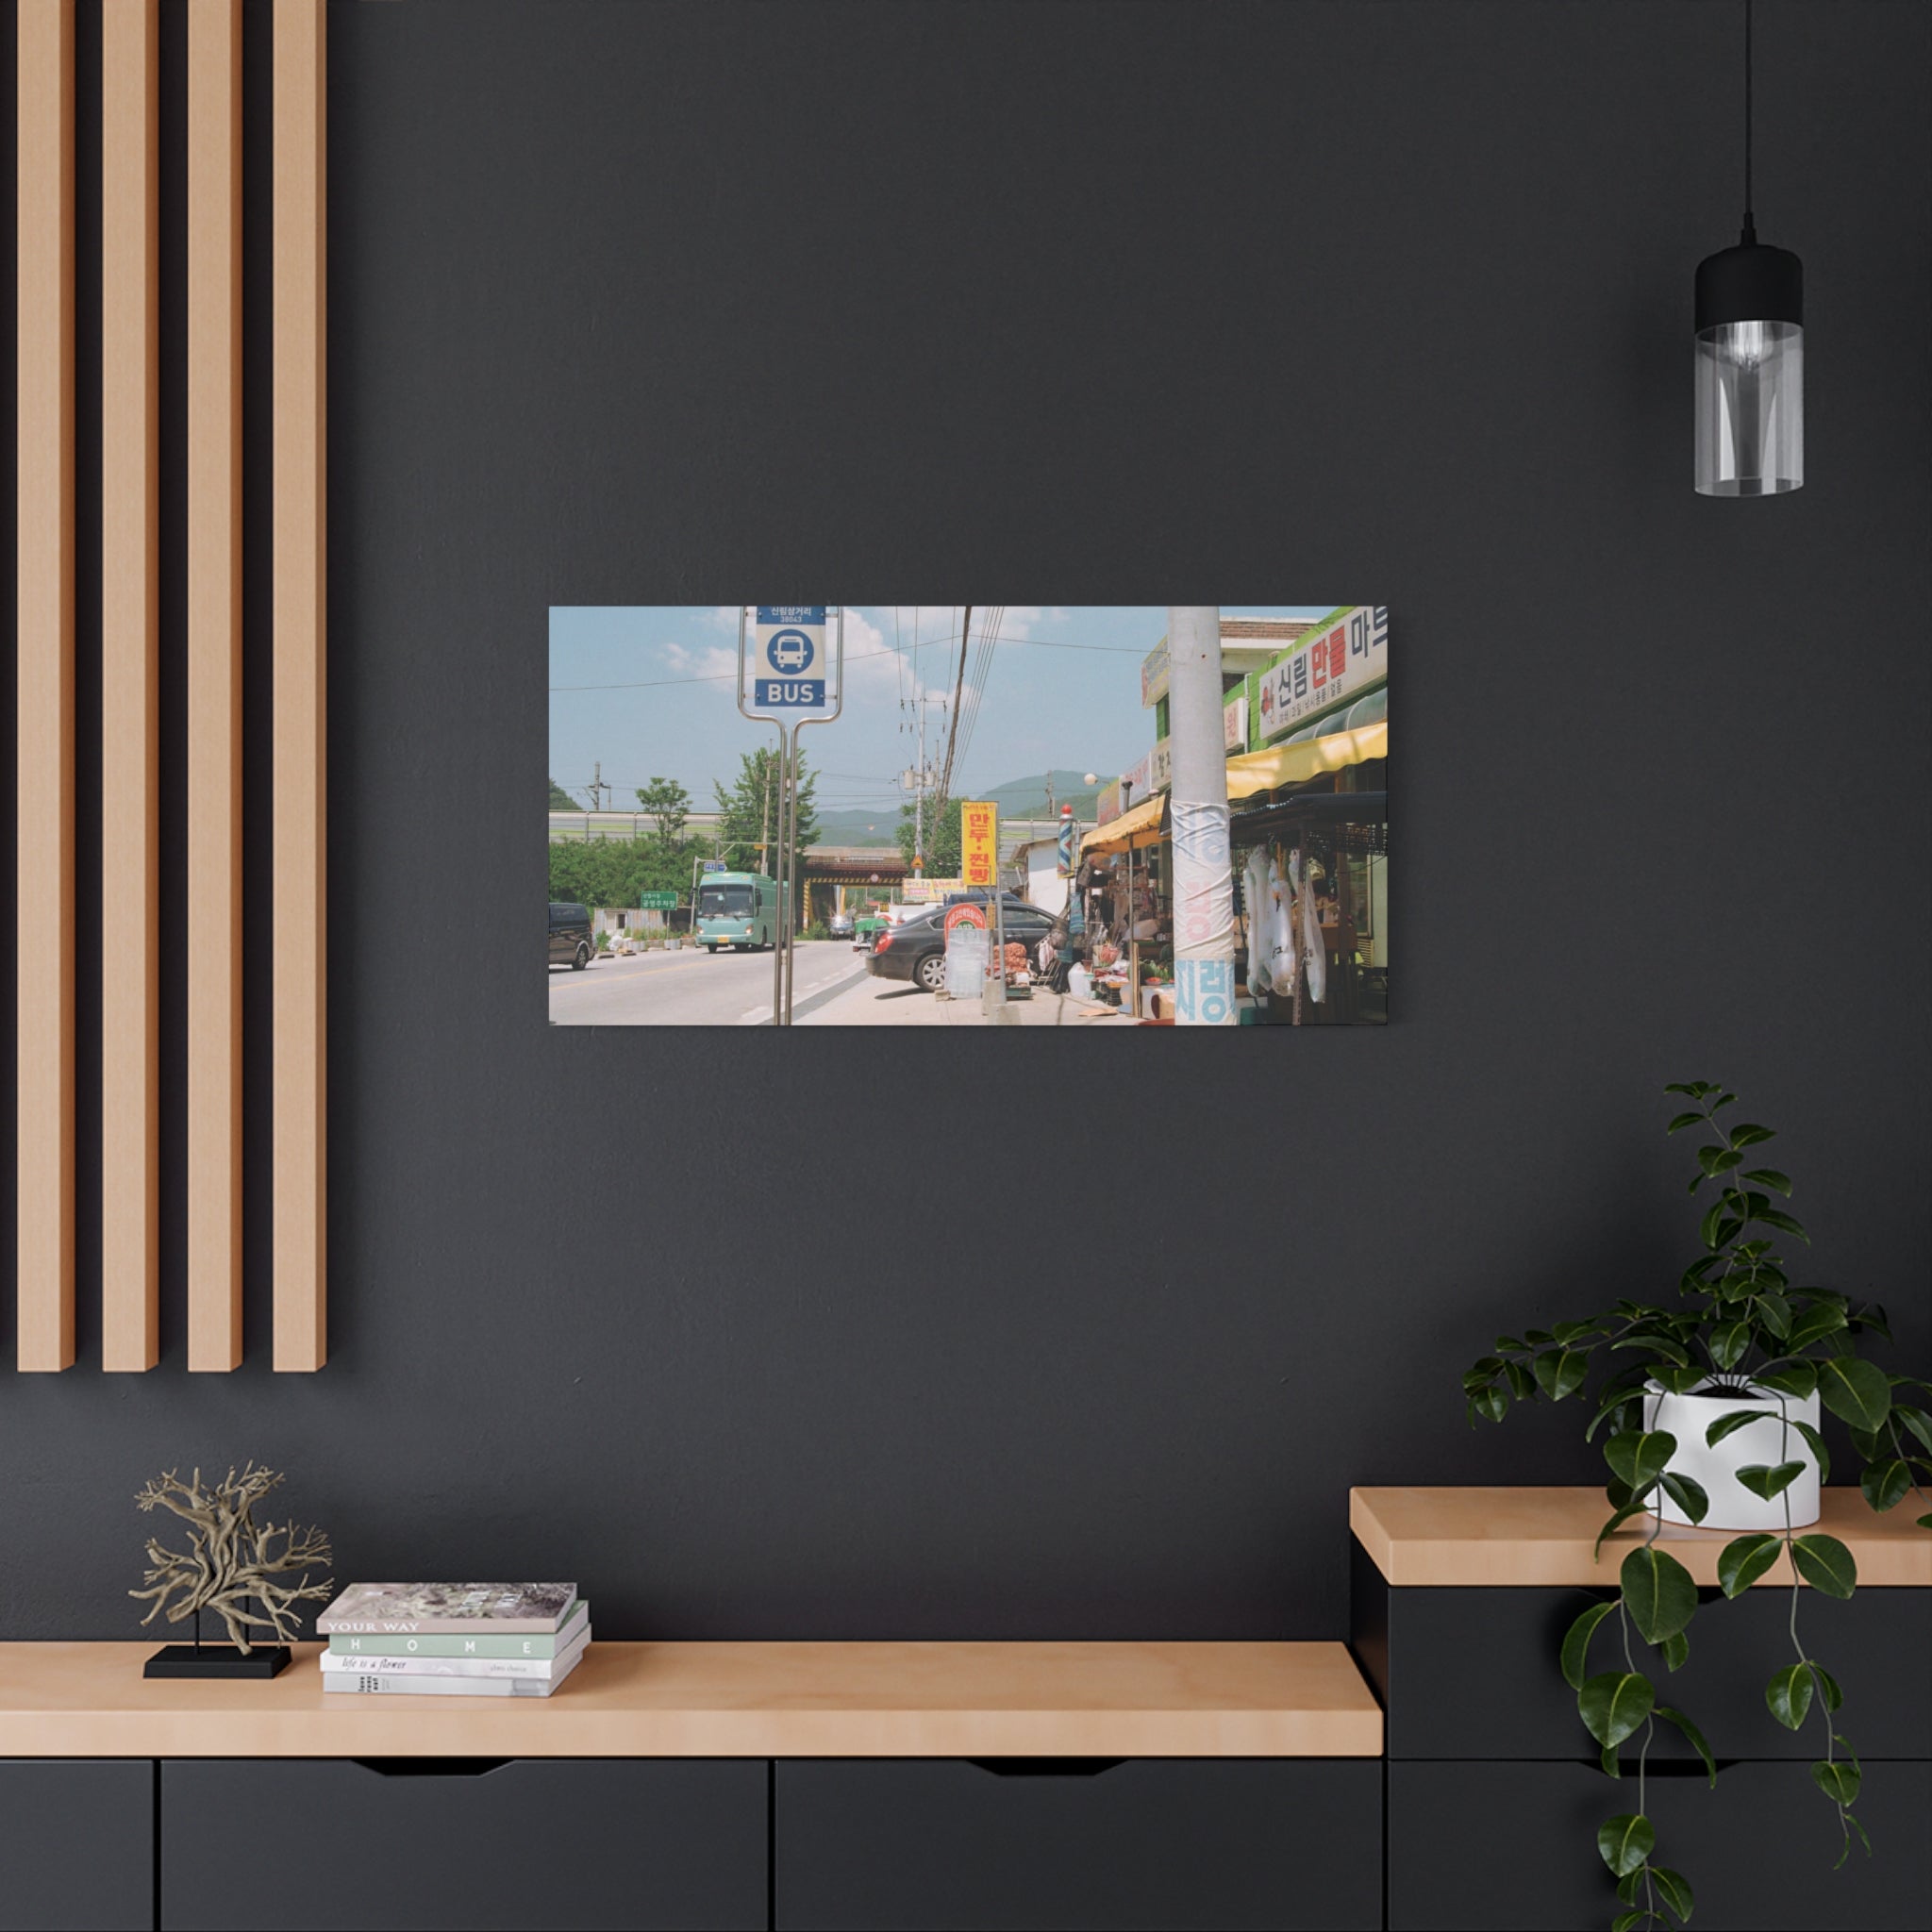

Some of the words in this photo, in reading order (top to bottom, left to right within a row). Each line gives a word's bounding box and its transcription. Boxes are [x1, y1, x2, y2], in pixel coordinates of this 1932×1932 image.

[771, 607, 812, 617] 신림삼거리
[1277, 652, 1307, 708] 신림
[1311, 624, 1346, 691] 만물
[767, 683, 814, 703] BUS
[327, 1622, 377, 1632] YOUR
[383, 1622, 421, 1632] WAY
[341, 1657, 357, 1671] life
[377, 1657, 407, 1673] flower
